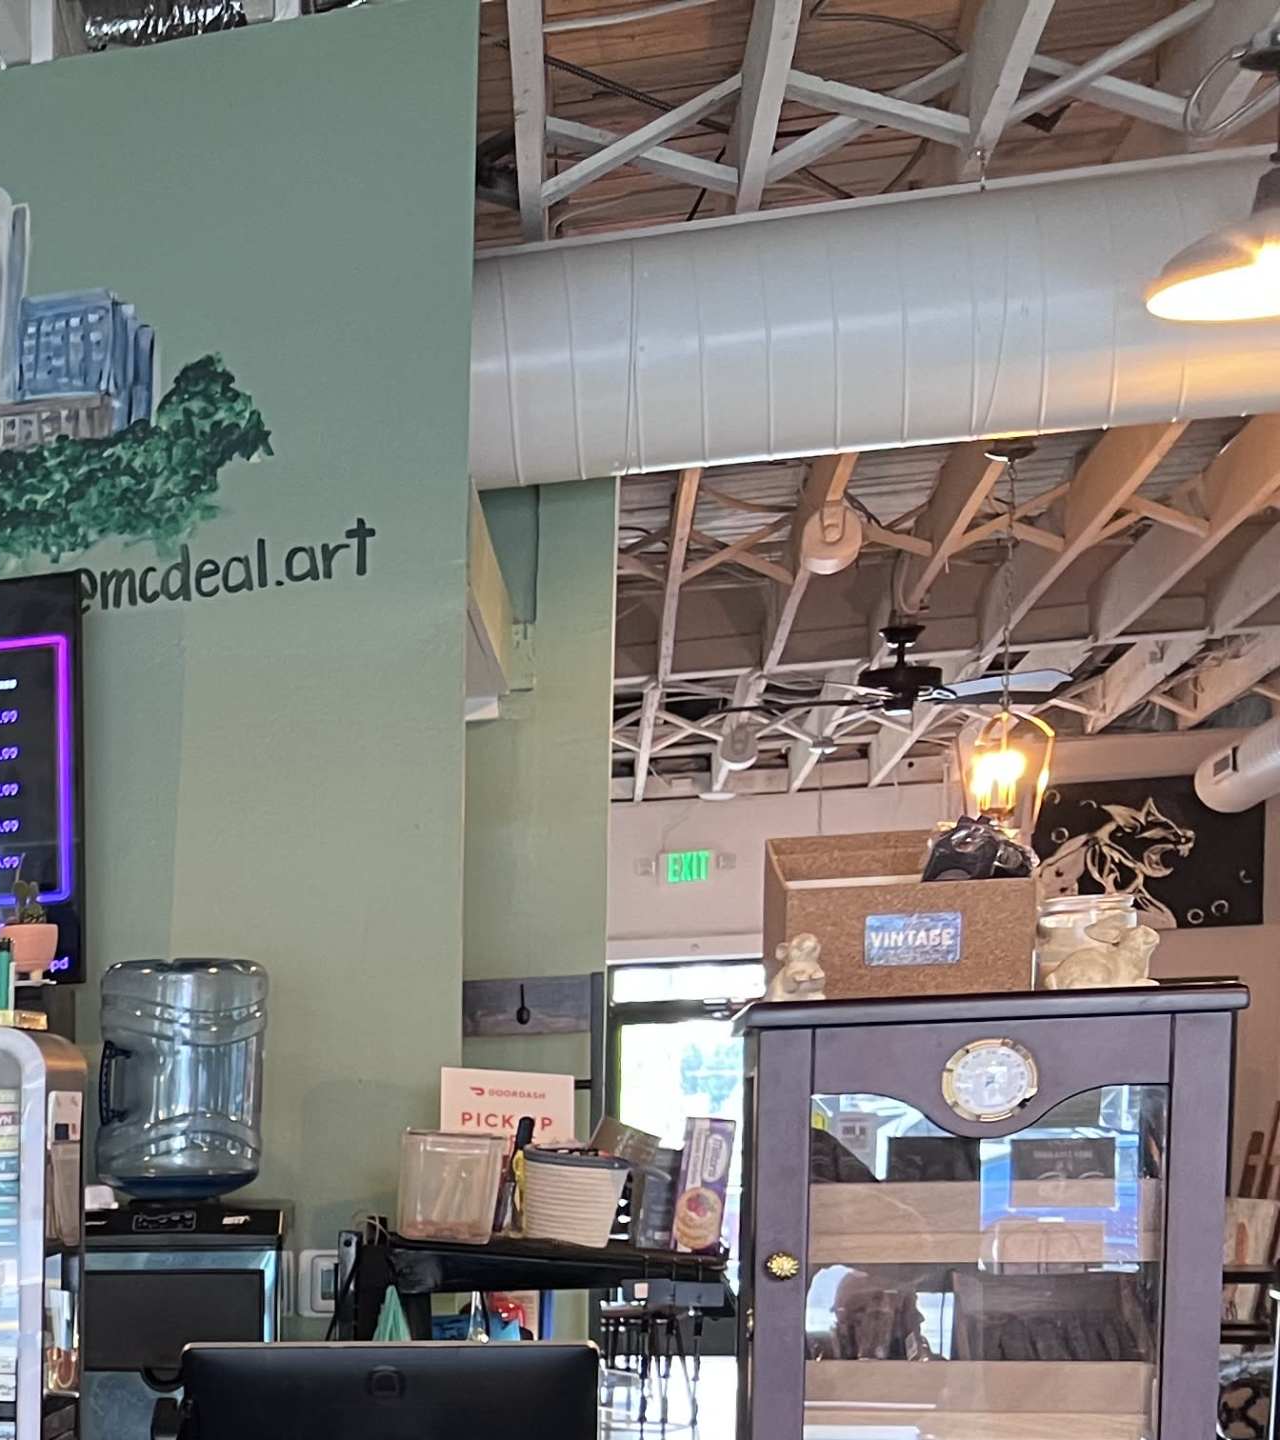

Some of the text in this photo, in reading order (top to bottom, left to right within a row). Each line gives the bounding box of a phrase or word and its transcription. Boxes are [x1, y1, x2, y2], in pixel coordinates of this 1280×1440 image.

[667, 849, 710, 884] EXIT
[869, 928, 954, 949] VINTAGE
[488, 1088, 547, 1101] DOORDASH
[460, 1112, 514, 1129] PICK
